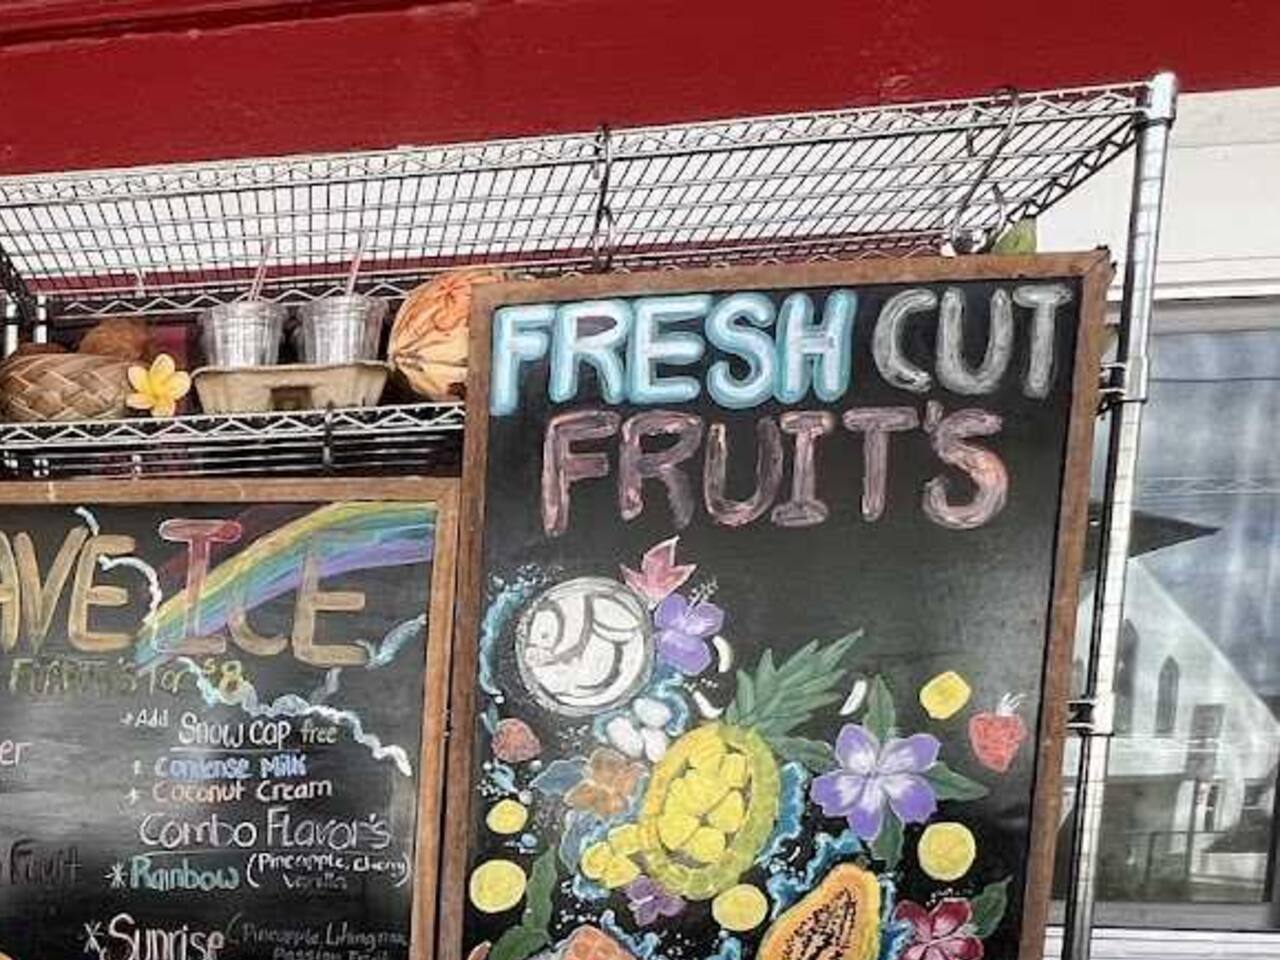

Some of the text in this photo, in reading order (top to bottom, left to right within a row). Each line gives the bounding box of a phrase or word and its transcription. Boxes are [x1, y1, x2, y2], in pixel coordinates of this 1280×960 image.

[488, 286, 1073, 416] FRESH CUT
[540, 401, 1009, 537] FRUIT'S
[155, 517, 370, 667] ICE
[300, 718, 338, 745] free
[152, 779, 333, 801] Coconut Cream
[138, 811, 258, 850] Combo
[130, 856, 241, 891] Rainbow
